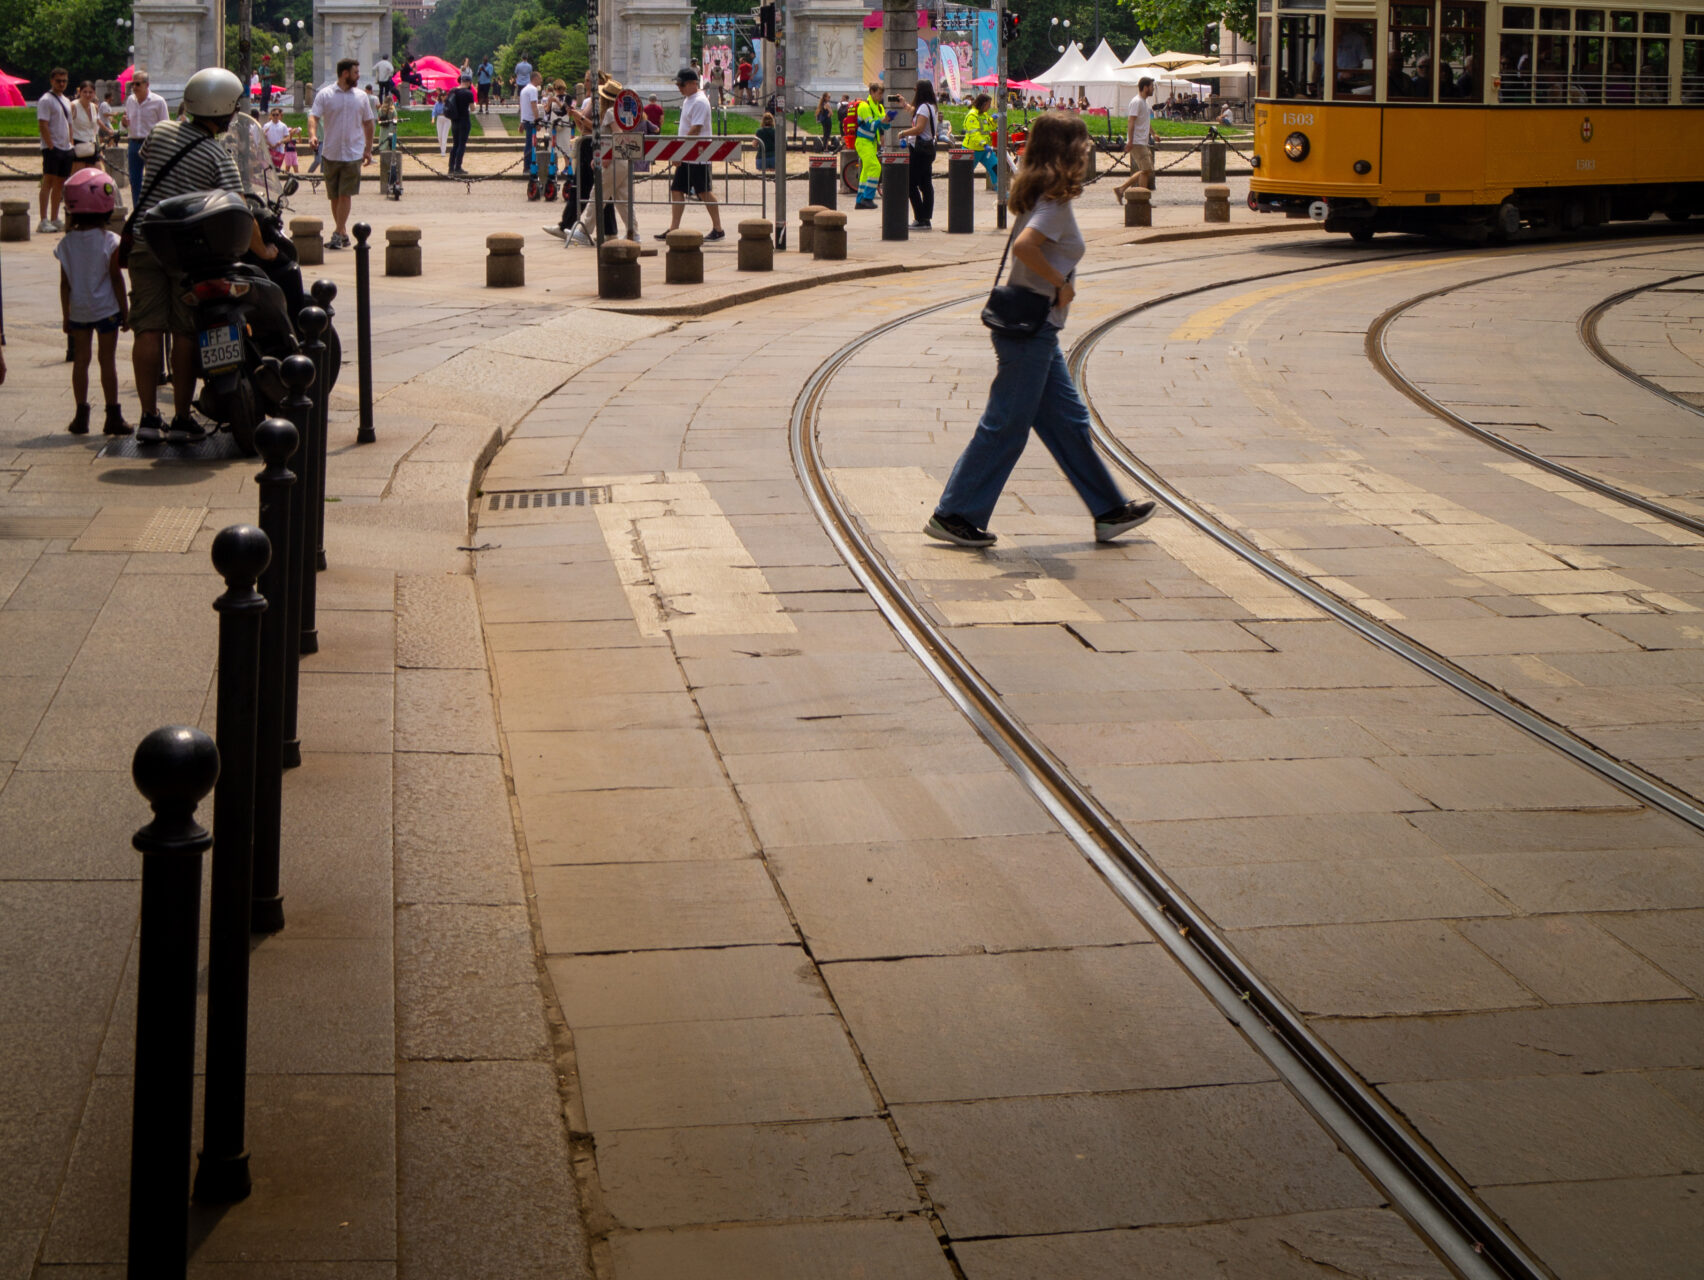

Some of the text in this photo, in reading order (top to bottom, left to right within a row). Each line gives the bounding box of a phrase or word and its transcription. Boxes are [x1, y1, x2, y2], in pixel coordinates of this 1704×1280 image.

[1283, 112, 1314, 126] 1503
[209, 329, 222, 345] FF
[203, 343, 239, 365] 33055
